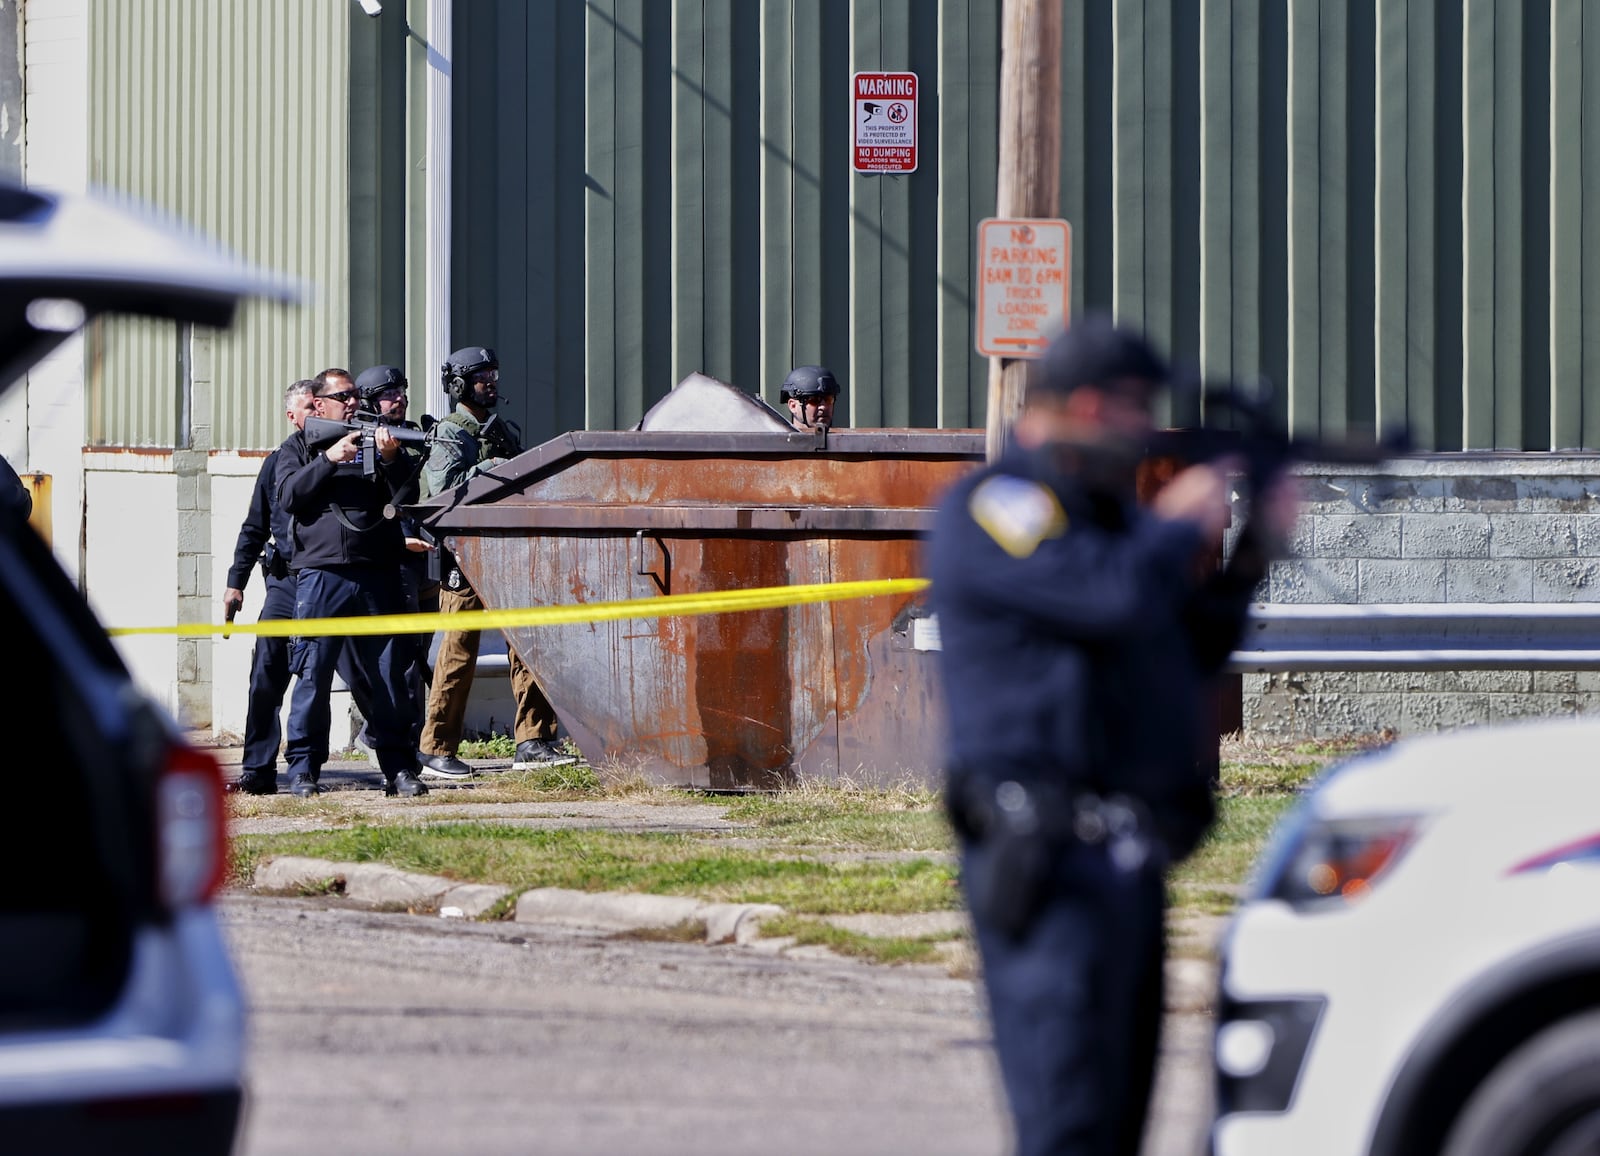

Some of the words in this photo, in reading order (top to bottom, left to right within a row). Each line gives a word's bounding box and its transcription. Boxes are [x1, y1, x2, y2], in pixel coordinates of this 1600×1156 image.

[858, 79, 913, 96] WARNING
[859, 148, 870, 157] NO
[873, 148, 911, 157] DUMPING
[1010, 226, 1036, 245] NO
[991, 247, 1057, 264] PARKING
[1018, 267, 1032, 284] TO
[1036, 267, 1062, 284] 6PM
[1006, 287, 1042, 299] TRUCK
[997, 302, 1048, 315] LOADING
[1007, 318, 1038, 331] ZONE
